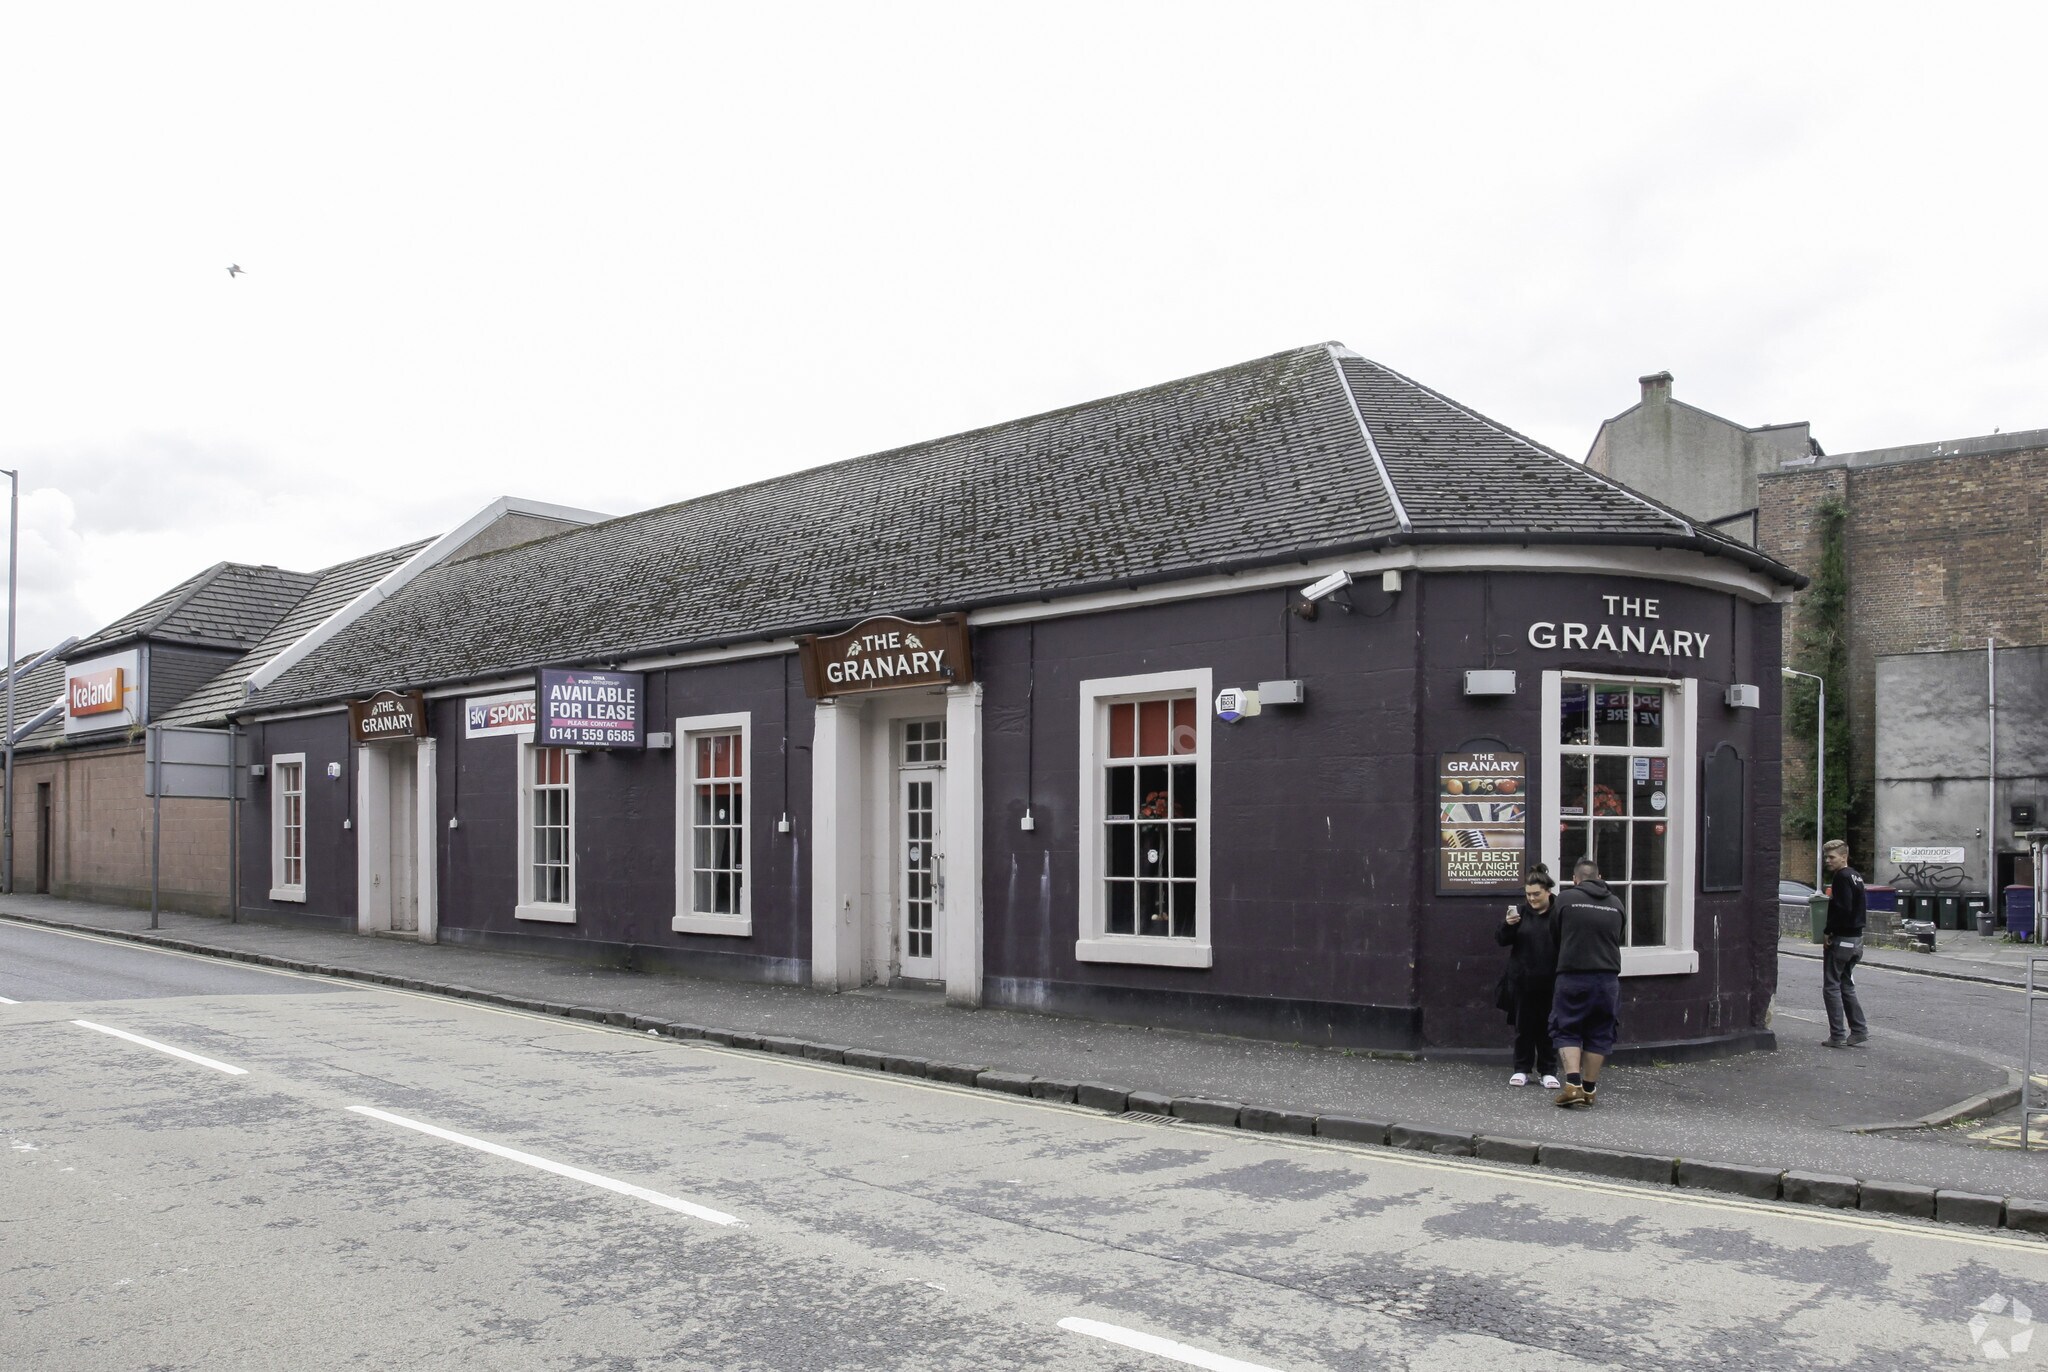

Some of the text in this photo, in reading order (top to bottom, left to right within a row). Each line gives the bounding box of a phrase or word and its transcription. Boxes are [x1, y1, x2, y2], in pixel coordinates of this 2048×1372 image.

[1602, 594, 1660, 619] THE
[862, 632, 901, 652] THE
[1528, 621, 1711, 659] GRANARY
[826, 649, 945, 683] GRANARY
[73, 677, 113, 709] Iceland
[550, 684, 635, 704] AVAILABLE
[377, 700, 395, 713] THE
[550, 701, 635, 721] FOR LEASE
[361, 713, 414, 733] GRANARY
[470, 706, 487, 728] sky
[590, 720, 618, 728] CONTACT
[549, 727, 635, 742] 0141 559 6585
[1447, 761, 1520, 772] GRANARY
[1472, 753, 1495, 761] THE
[1447, 851, 1520, 862] THE BEST
[1447, 862, 1520, 870] PARTY NIGHT
